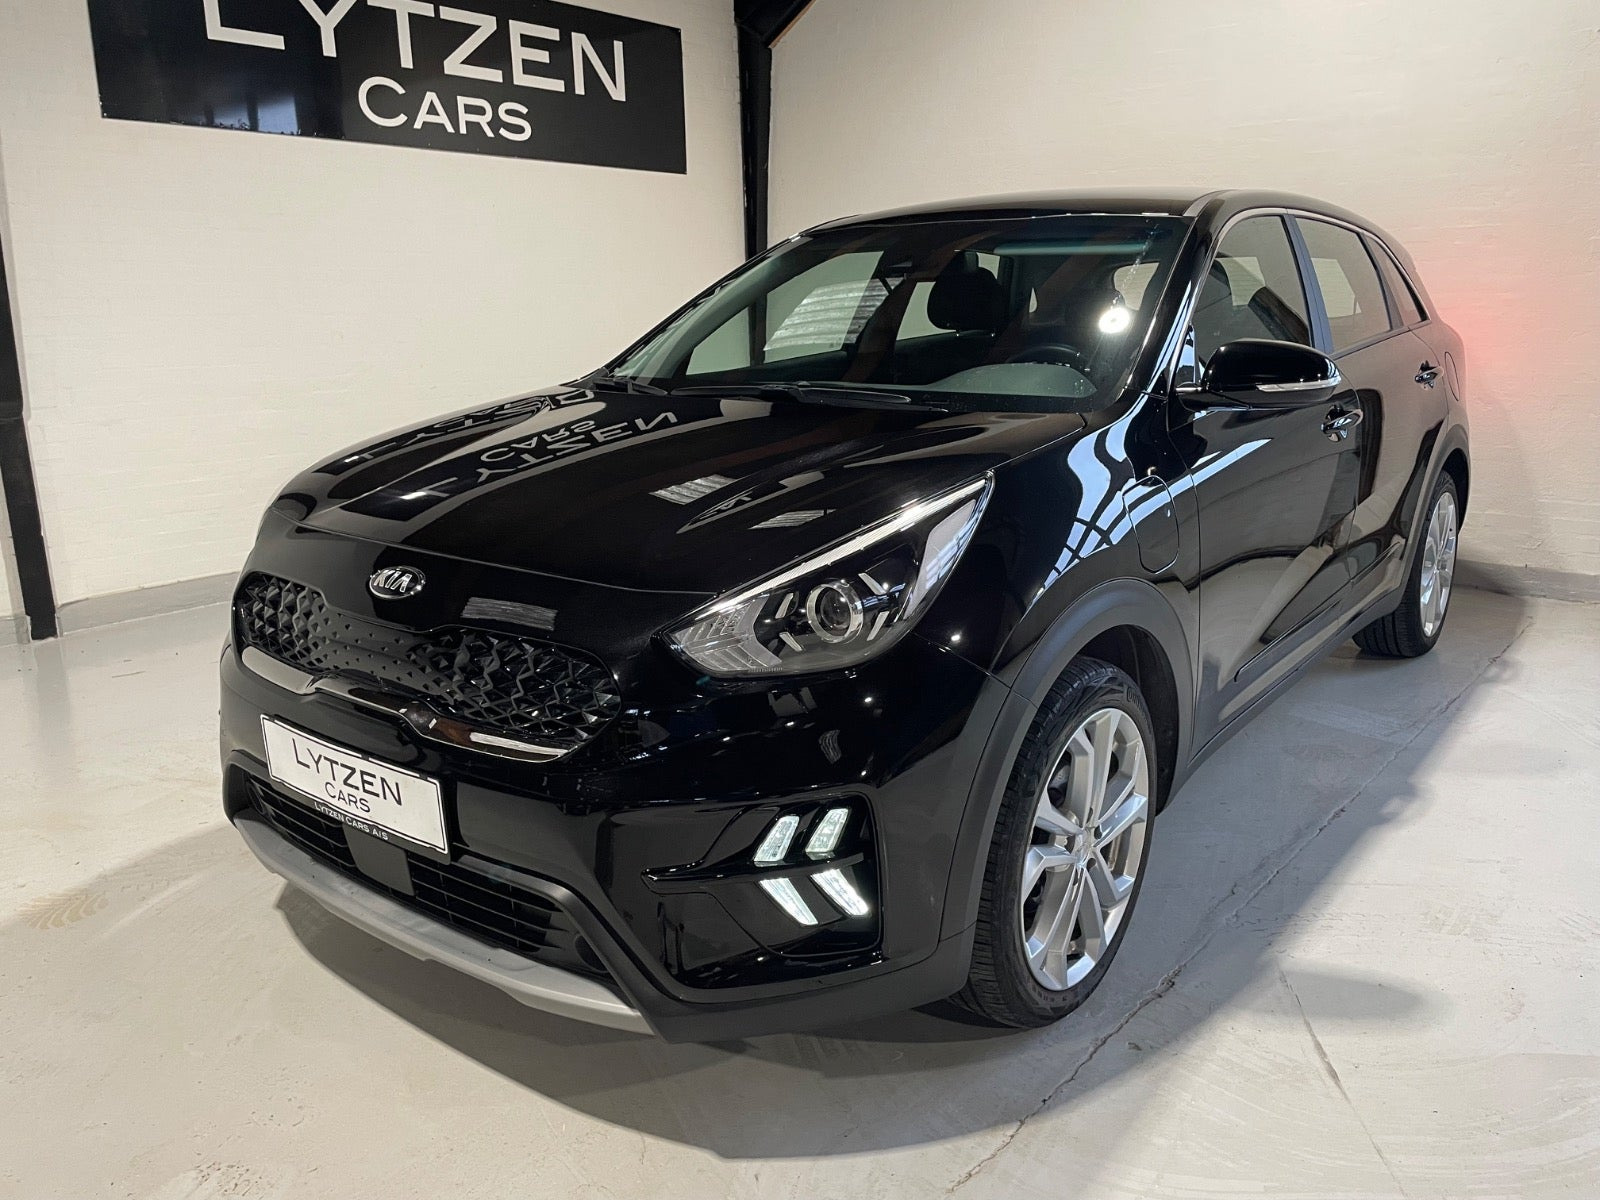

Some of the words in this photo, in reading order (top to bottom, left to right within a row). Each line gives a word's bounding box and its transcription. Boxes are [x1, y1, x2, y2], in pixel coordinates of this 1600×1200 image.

[204, 0, 626, 102] LYTZEN
[358, 76, 532, 142] CARS
[373, 569, 412, 593] KIA
[292, 737, 403, 806] LYTZEN
[314, 801, 345, 823] LYTZEN
[346, 816, 370, 833] CARS
[324, 781, 371, 813] CARS
